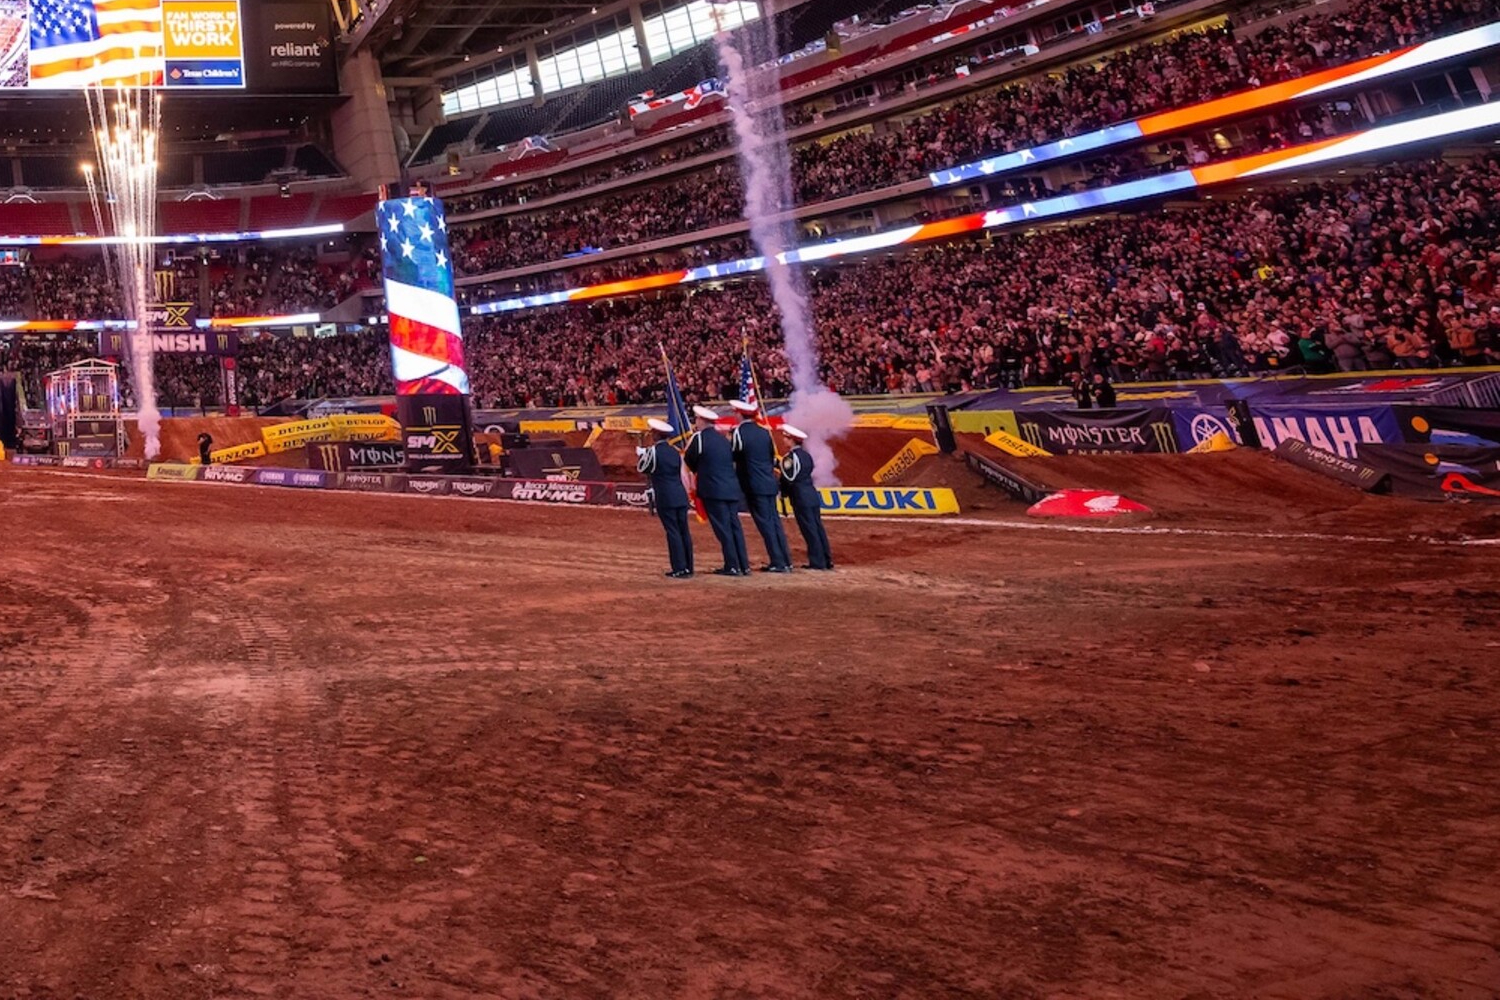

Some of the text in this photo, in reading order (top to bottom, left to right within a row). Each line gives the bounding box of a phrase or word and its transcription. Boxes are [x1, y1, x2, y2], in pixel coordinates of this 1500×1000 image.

[166, 11, 189, 20] FAN
[191, 11, 225, 20] WORK
[166, 20, 237, 32] THIRSTY
[274, 22, 316, 31] powered by
[172, 32, 234, 47] WORK
[271, 42, 321, 57] reliant
[132, 334, 207, 352] NISH
[278, 421, 330, 435] DUNLOP
[346, 418, 387, 426] DUNLOP
[407, 430, 460, 453] SMX
[1048, 423, 1147, 446] MONSTER
[349, 447, 405, 465] MONS
[1305, 447, 1359, 473] MONSTER
[879, 447, 917, 482] Insta360
[408, 480, 439, 492] TRIUMPH
[452, 482, 485, 494] TRIUMPH
[548, 482, 587, 492] MOUNTAIN
[615, 490, 650, 505] TRIUM
[818, 490, 937, 510] UZUKI
